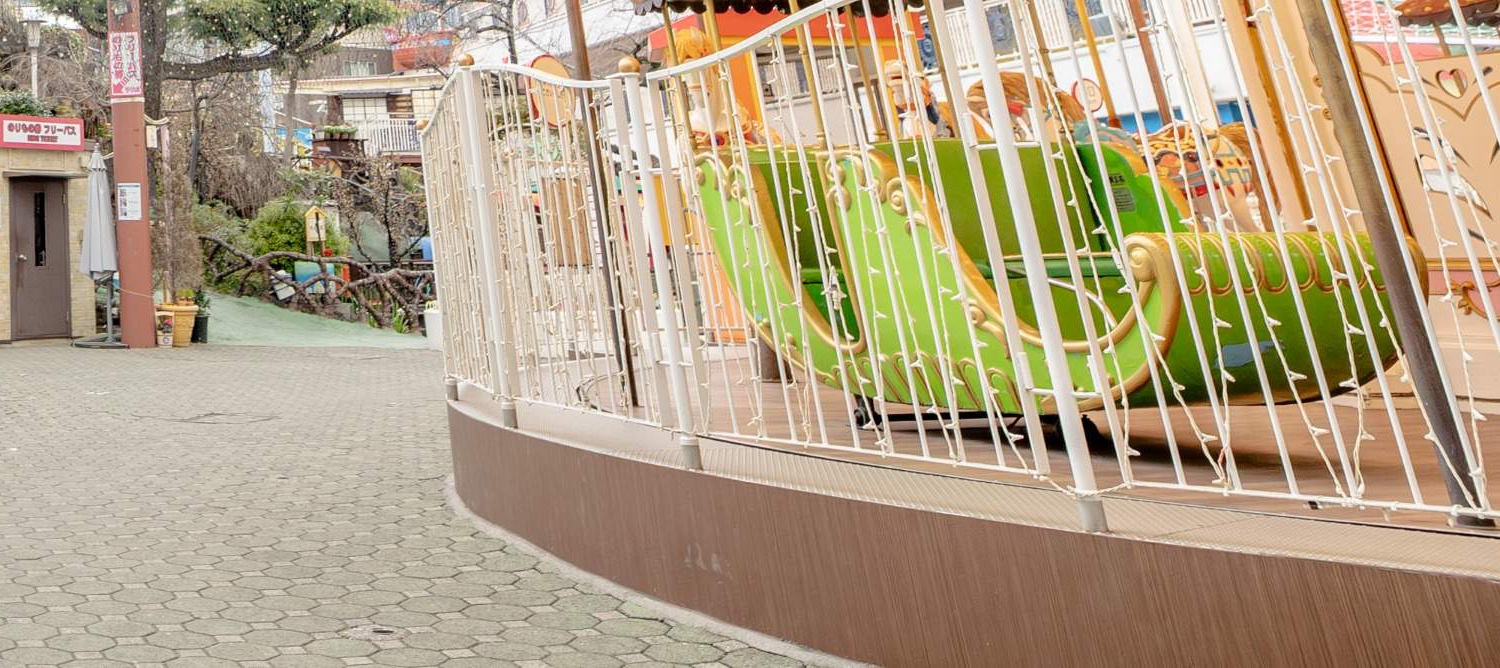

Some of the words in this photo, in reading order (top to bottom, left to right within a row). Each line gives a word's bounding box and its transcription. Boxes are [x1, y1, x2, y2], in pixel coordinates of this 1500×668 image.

[43, 124, 77, 136] フリーパス
